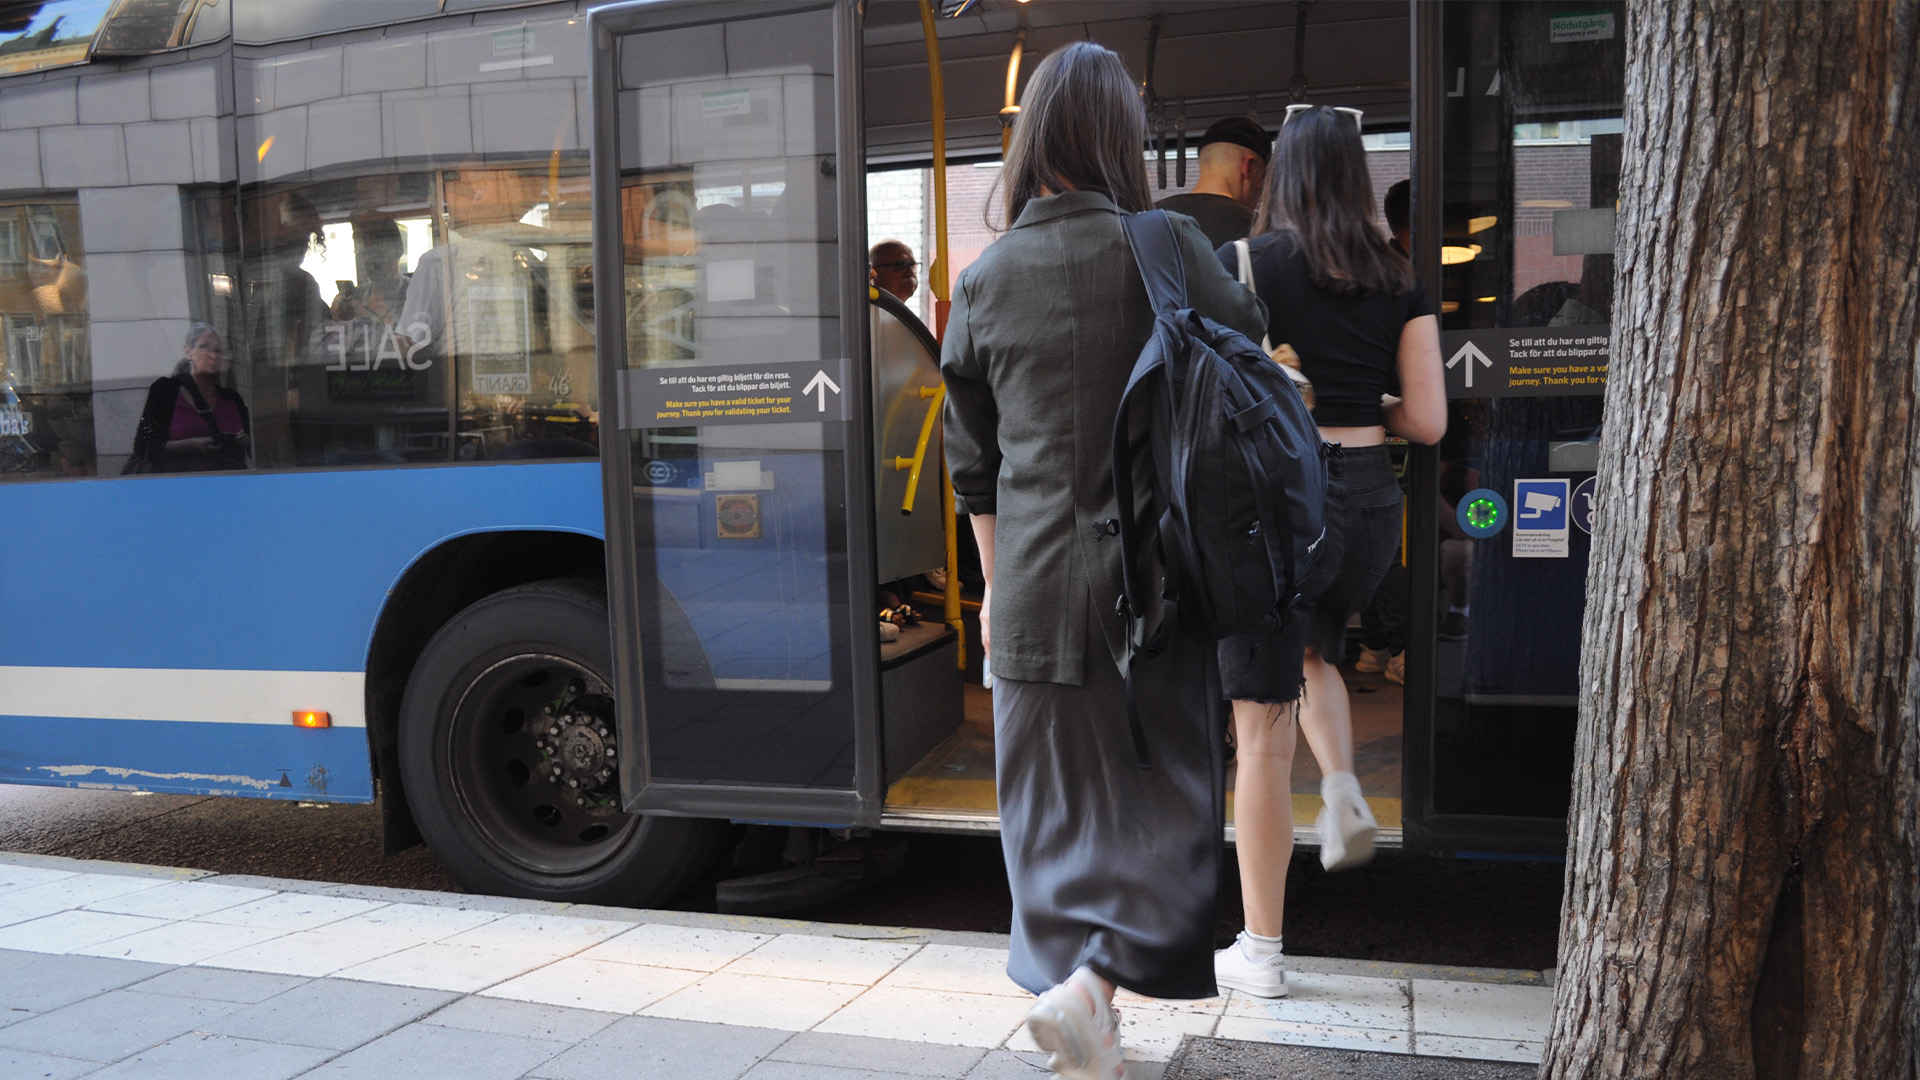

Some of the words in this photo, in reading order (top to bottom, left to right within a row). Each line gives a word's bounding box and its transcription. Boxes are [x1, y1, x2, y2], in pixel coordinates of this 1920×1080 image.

[1553, 18, 1606, 30] Nödutgång
[1509, 339, 1520, 347] Se
[1587, 336, 1608, 346] giltig
[1568, 348, 1597, 357] blippar
[717, 374, 733, 383] giltig
[734, 373, 752, 382] biljett
[1544, 377, 1568, 385] Thank
[736, 383, 758, 391] blippar
[770, 382, 790, 390] biljett.
[725, 407, 755, 415] validating
